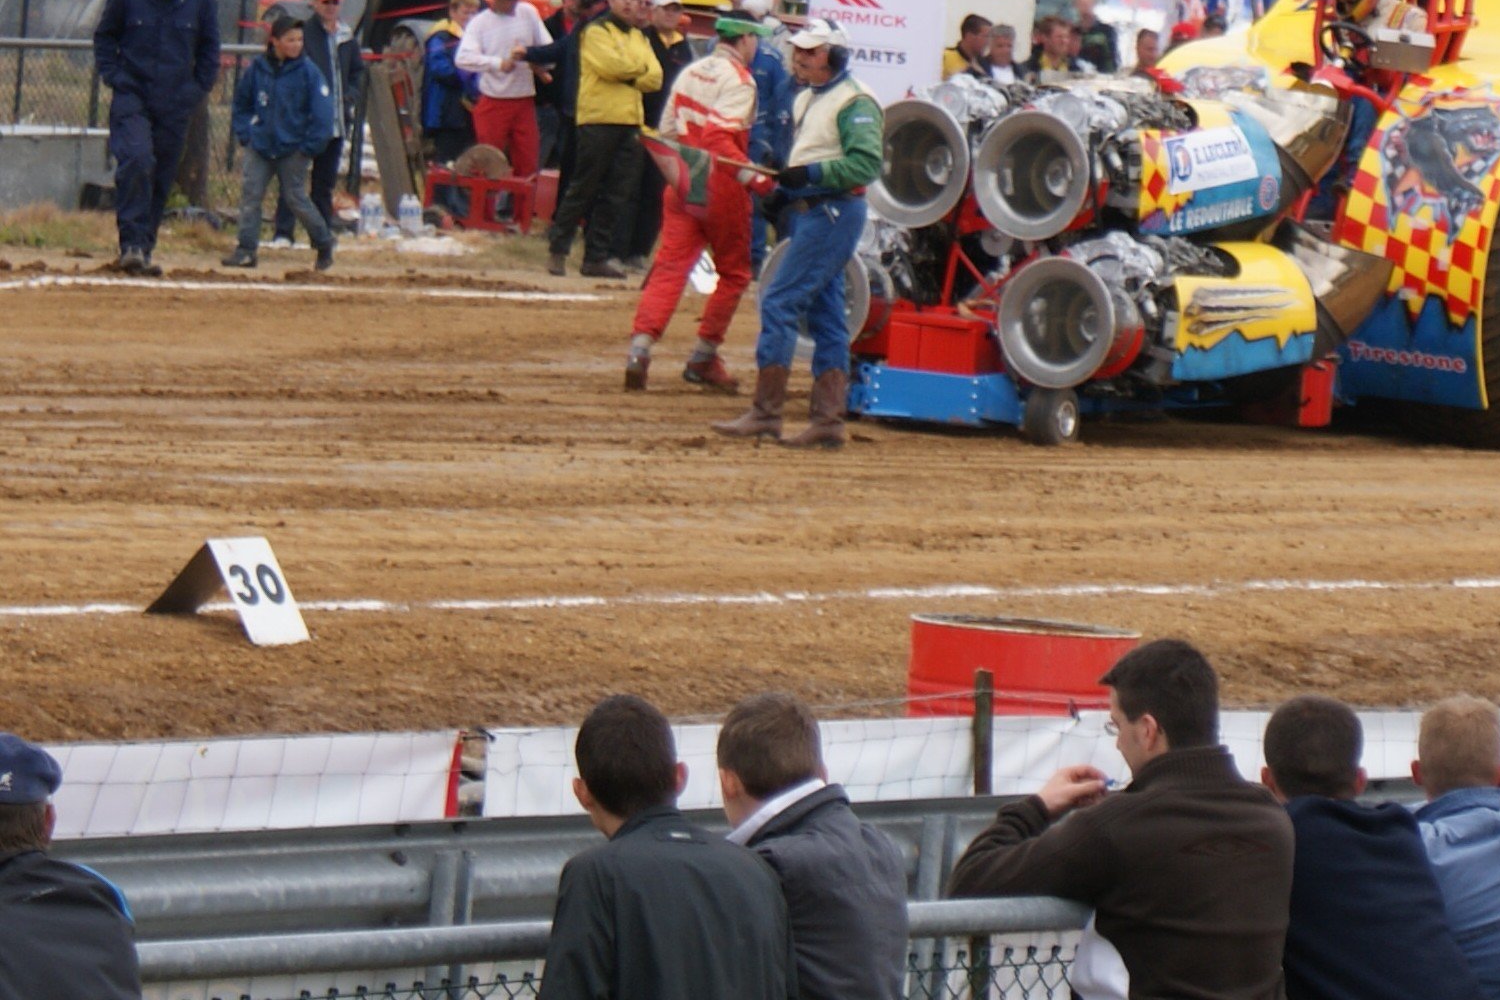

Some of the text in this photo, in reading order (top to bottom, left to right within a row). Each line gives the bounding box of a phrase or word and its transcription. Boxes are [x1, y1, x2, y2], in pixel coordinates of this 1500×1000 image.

[809, 8, 907, 29] CORMICK
[1347, 340, 1467, 373] Firestone
[228, 563, 286, 607] 30
